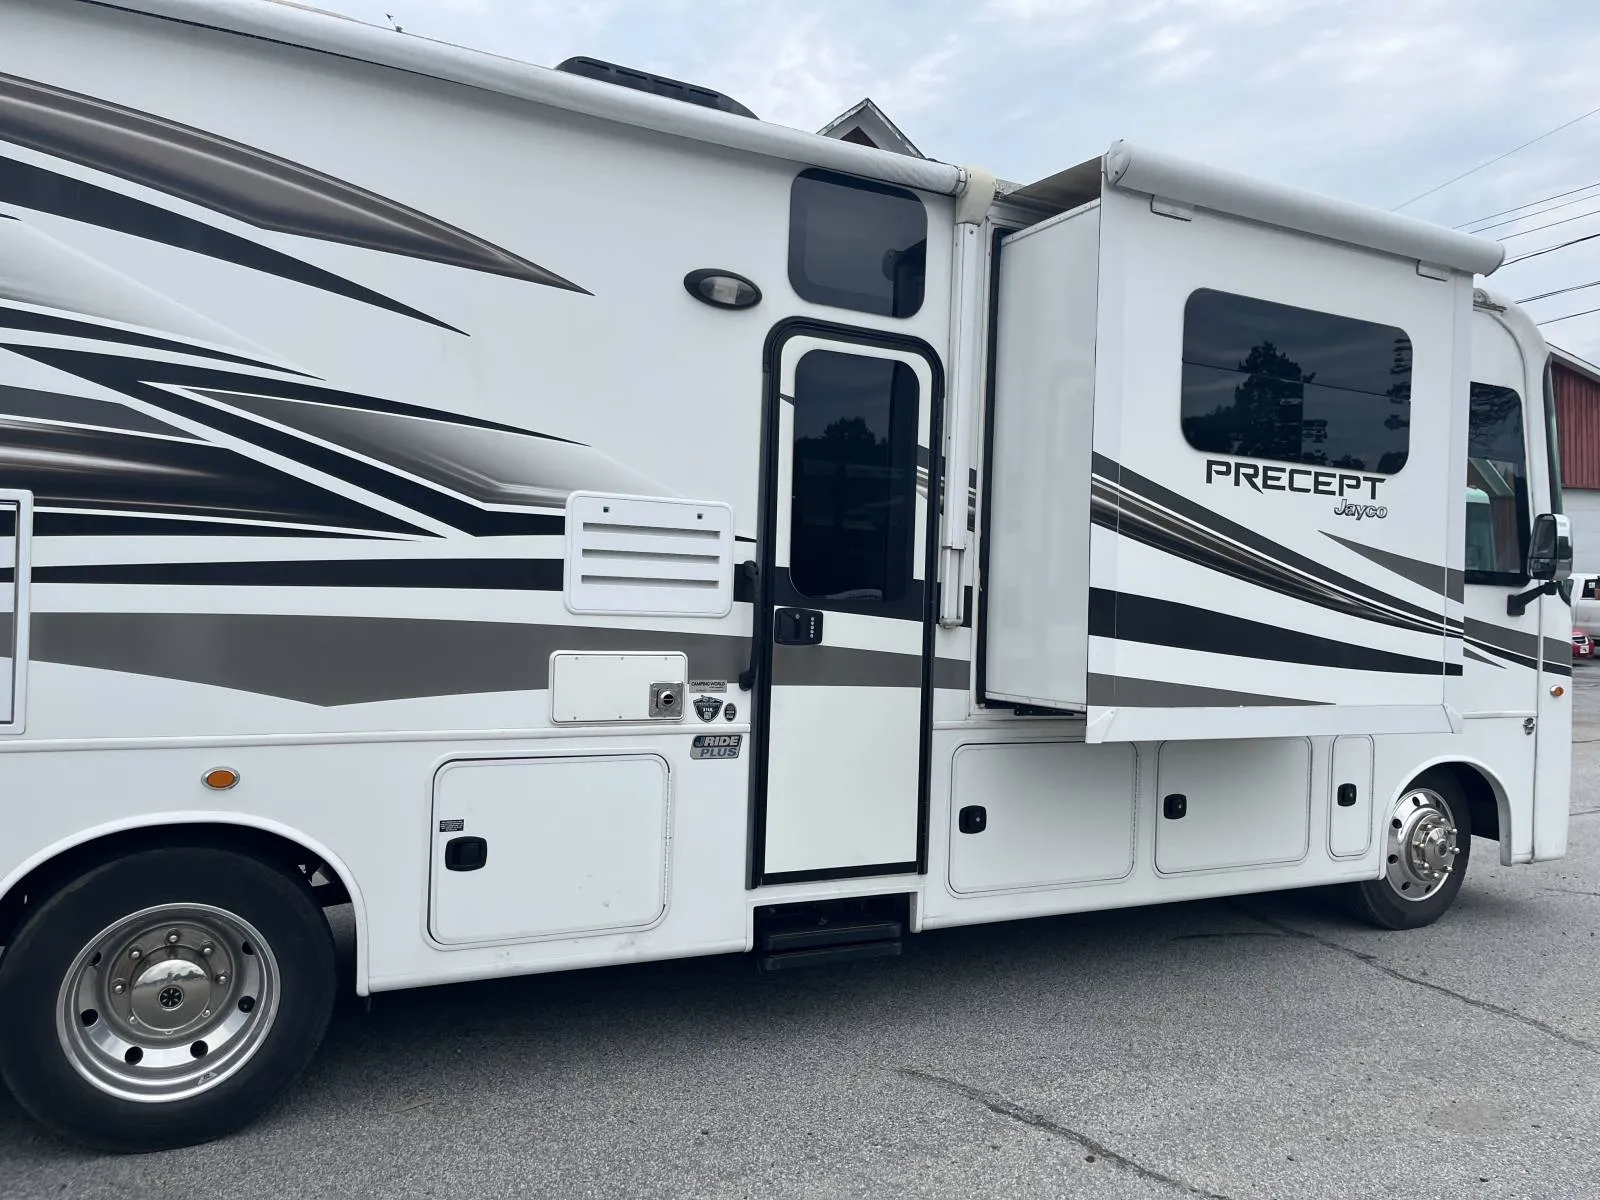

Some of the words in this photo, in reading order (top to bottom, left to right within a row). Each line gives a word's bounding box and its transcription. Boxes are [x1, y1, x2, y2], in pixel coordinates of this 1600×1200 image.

[1205, 459, 1386, 500] PRECEPT
[1333, 498, 1388, 520] Jayco
[700, 747, 738, 757] PLUS
